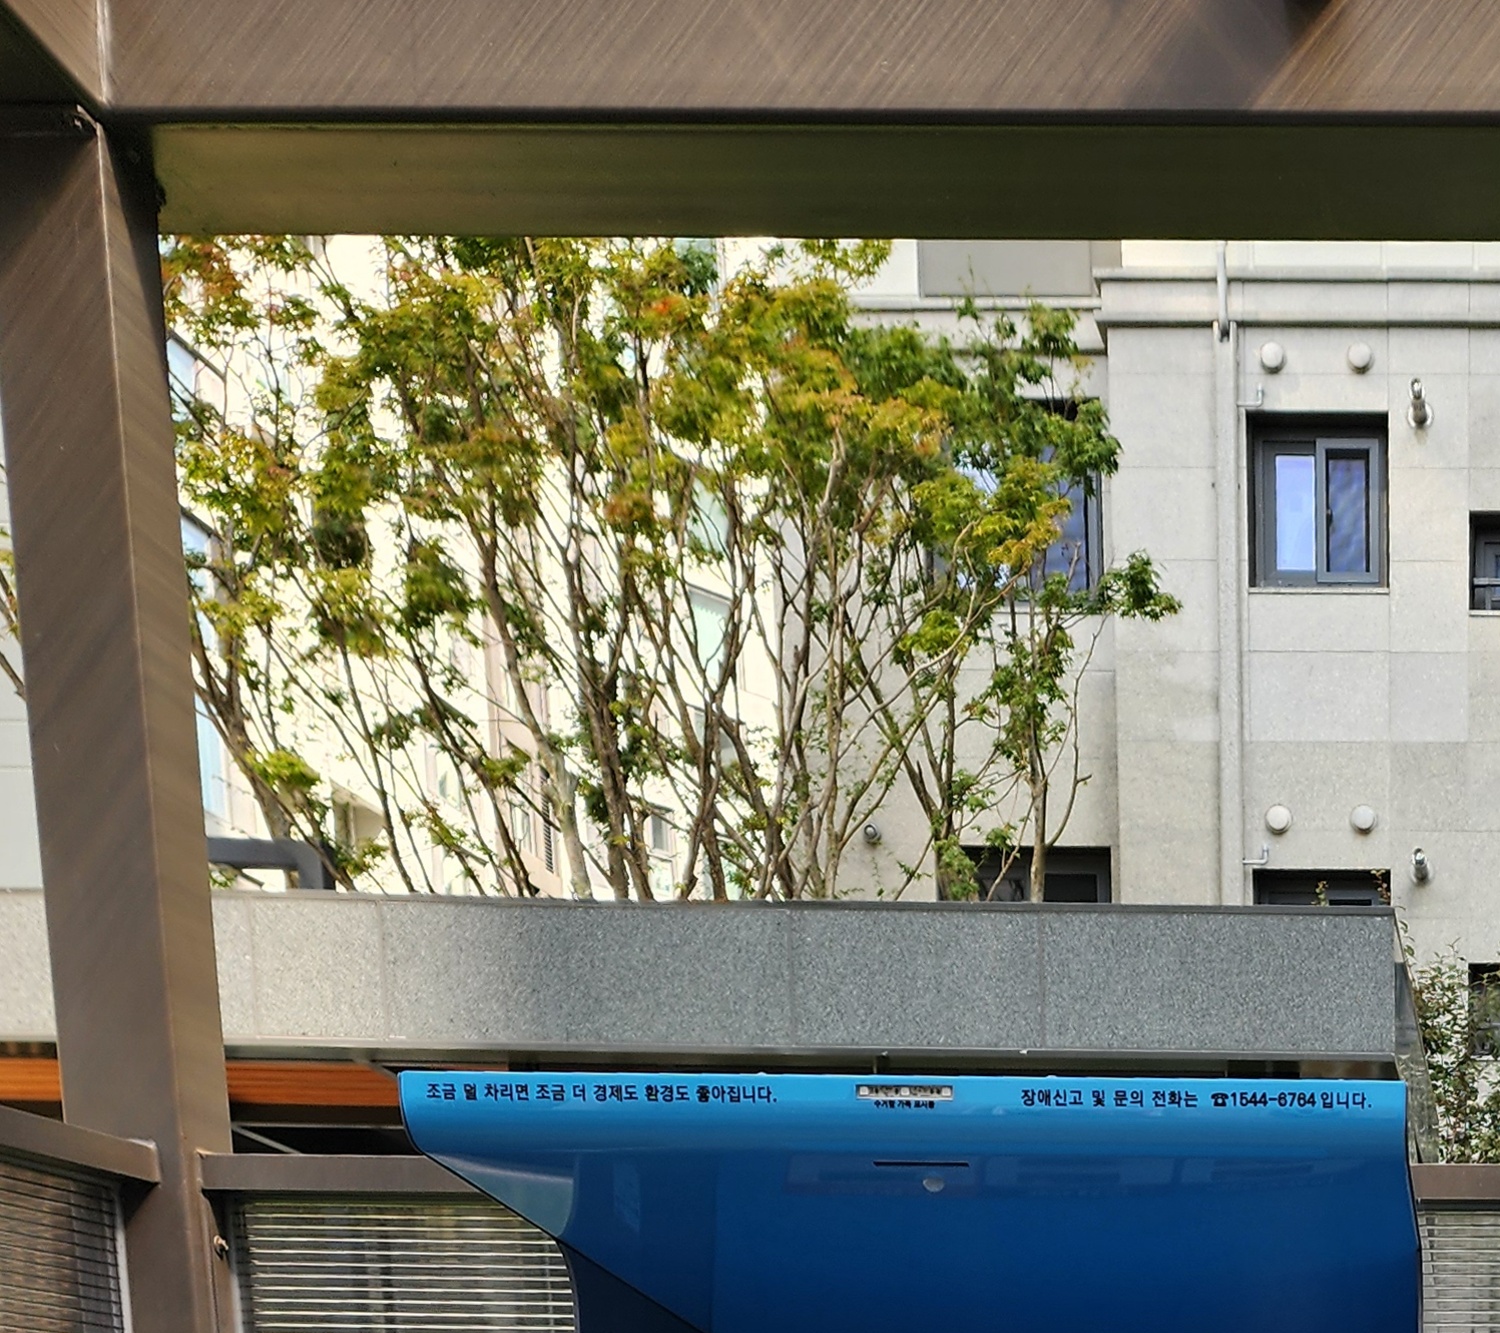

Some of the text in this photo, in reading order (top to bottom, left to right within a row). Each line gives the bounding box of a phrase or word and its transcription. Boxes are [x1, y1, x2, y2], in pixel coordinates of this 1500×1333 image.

[427, 1083, 456, 1101] 조금
[484, 1083, 528, 1102] 차리면
[535, 1084, 565, 1102] 조금
[572, 1084, 587, 1102] 더
[593, 1084, 638, 1103] 경제도
[644, 1084, 690, 1103] 환경도
[696, 1084, 777, 1104] 좋아집니다.
[1021, 1089, 1083, 1107] 장애신고
[1091, 1090, 1105, 1107] 및
[1113, 1090, 1145, 1107] 문의
[1151, 1090, 1198, 1108] 전화는
[1320, 1090, 1373, 1109] 입니다.
